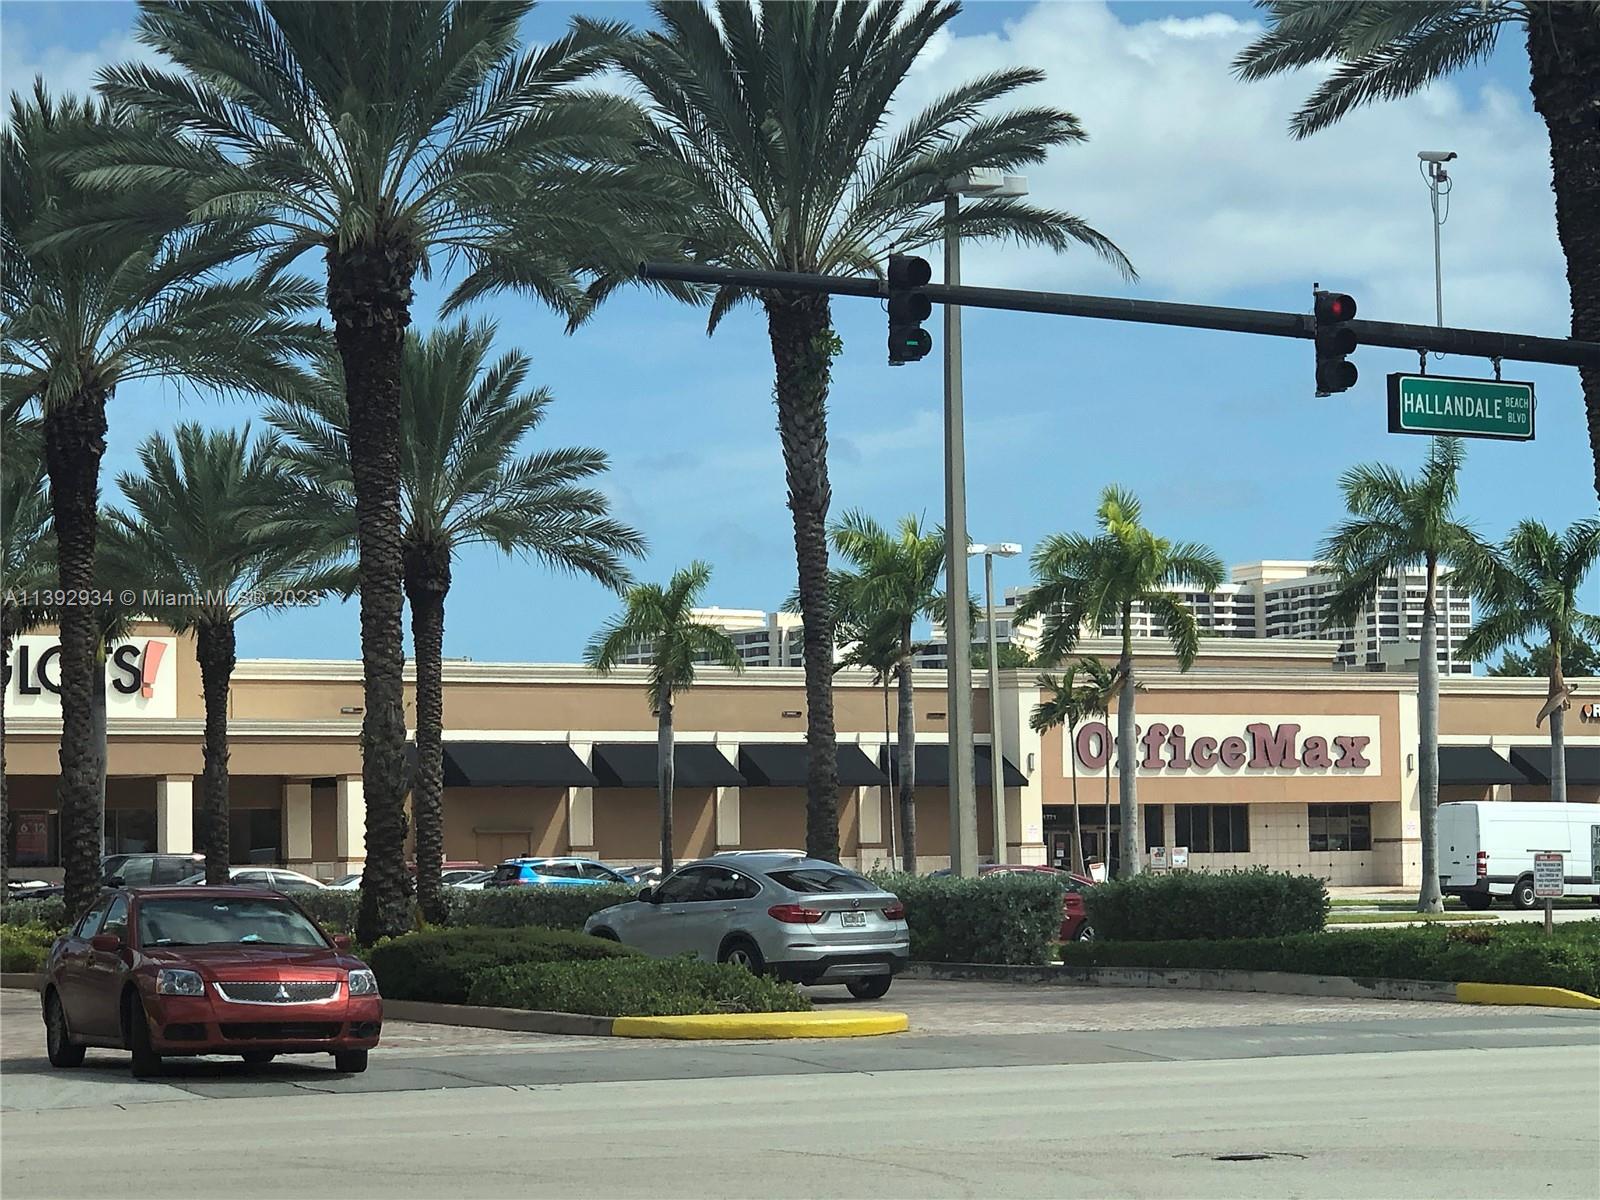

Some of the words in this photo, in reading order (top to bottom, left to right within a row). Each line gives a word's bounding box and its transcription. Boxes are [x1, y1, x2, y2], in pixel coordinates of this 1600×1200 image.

[1404, 392, 1502, 419] HALLANDALE
[1505, 396, 1529, 409] BEACH
[1507, 411, 1527, 424] BLVD
